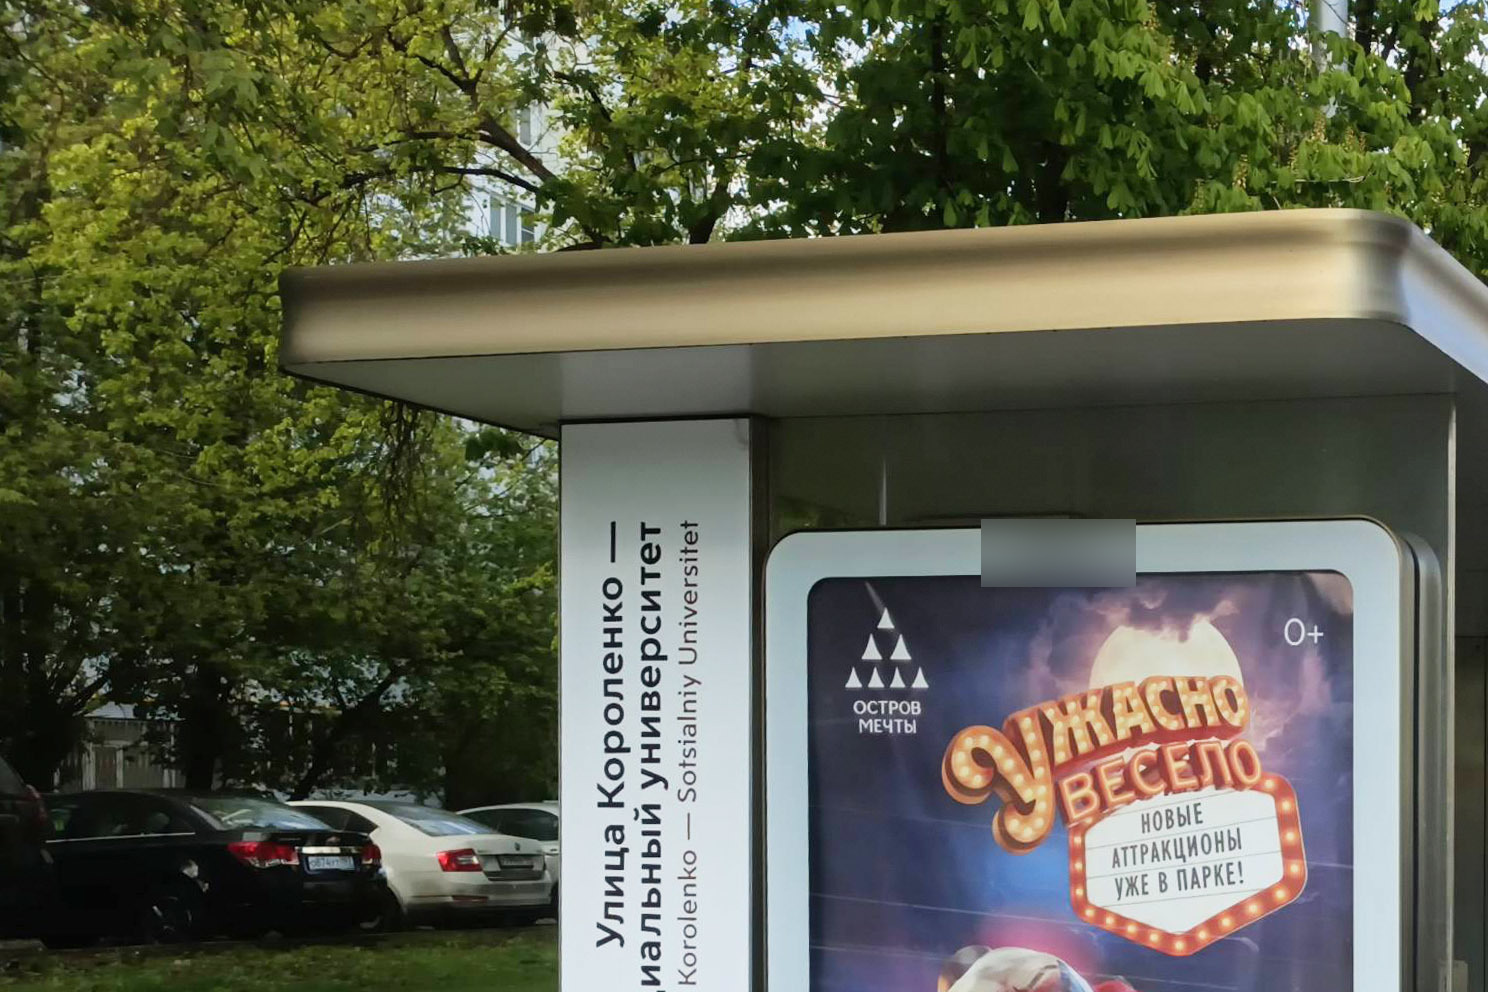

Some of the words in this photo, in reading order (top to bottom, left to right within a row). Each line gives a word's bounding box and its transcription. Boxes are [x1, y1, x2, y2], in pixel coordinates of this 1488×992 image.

[677, 520, 699, 664] Universitet
[1283, 618, 1324, 646] 0+
[596, 577, 632, 808] Короленко
[640, 521, 668, 790] университет
[852, 699, 922, 716] ОСТРОВ
[677, 674, 702, 802] Sotsialniy
[858, 718, 917, 734] МЕЧТЫ
[941, 675, 1250, 854] УЖАСНО
[1056, 737, 1263, 828] ВЕСЕЛО
[1141, 803, 1204, 834] НОВЫЕ
[596, 824, 630, 948] Улица
[1111, 835, 1243, 870] АТТРАКЦИОНЫ
[1115, 875, 1150, 901] УЖЕ
[1158, 872, 1169, 893] В
[1176, 861, 1245, 890] ПАРКЕ!
[677, 850, 698, 985] Korolenko
